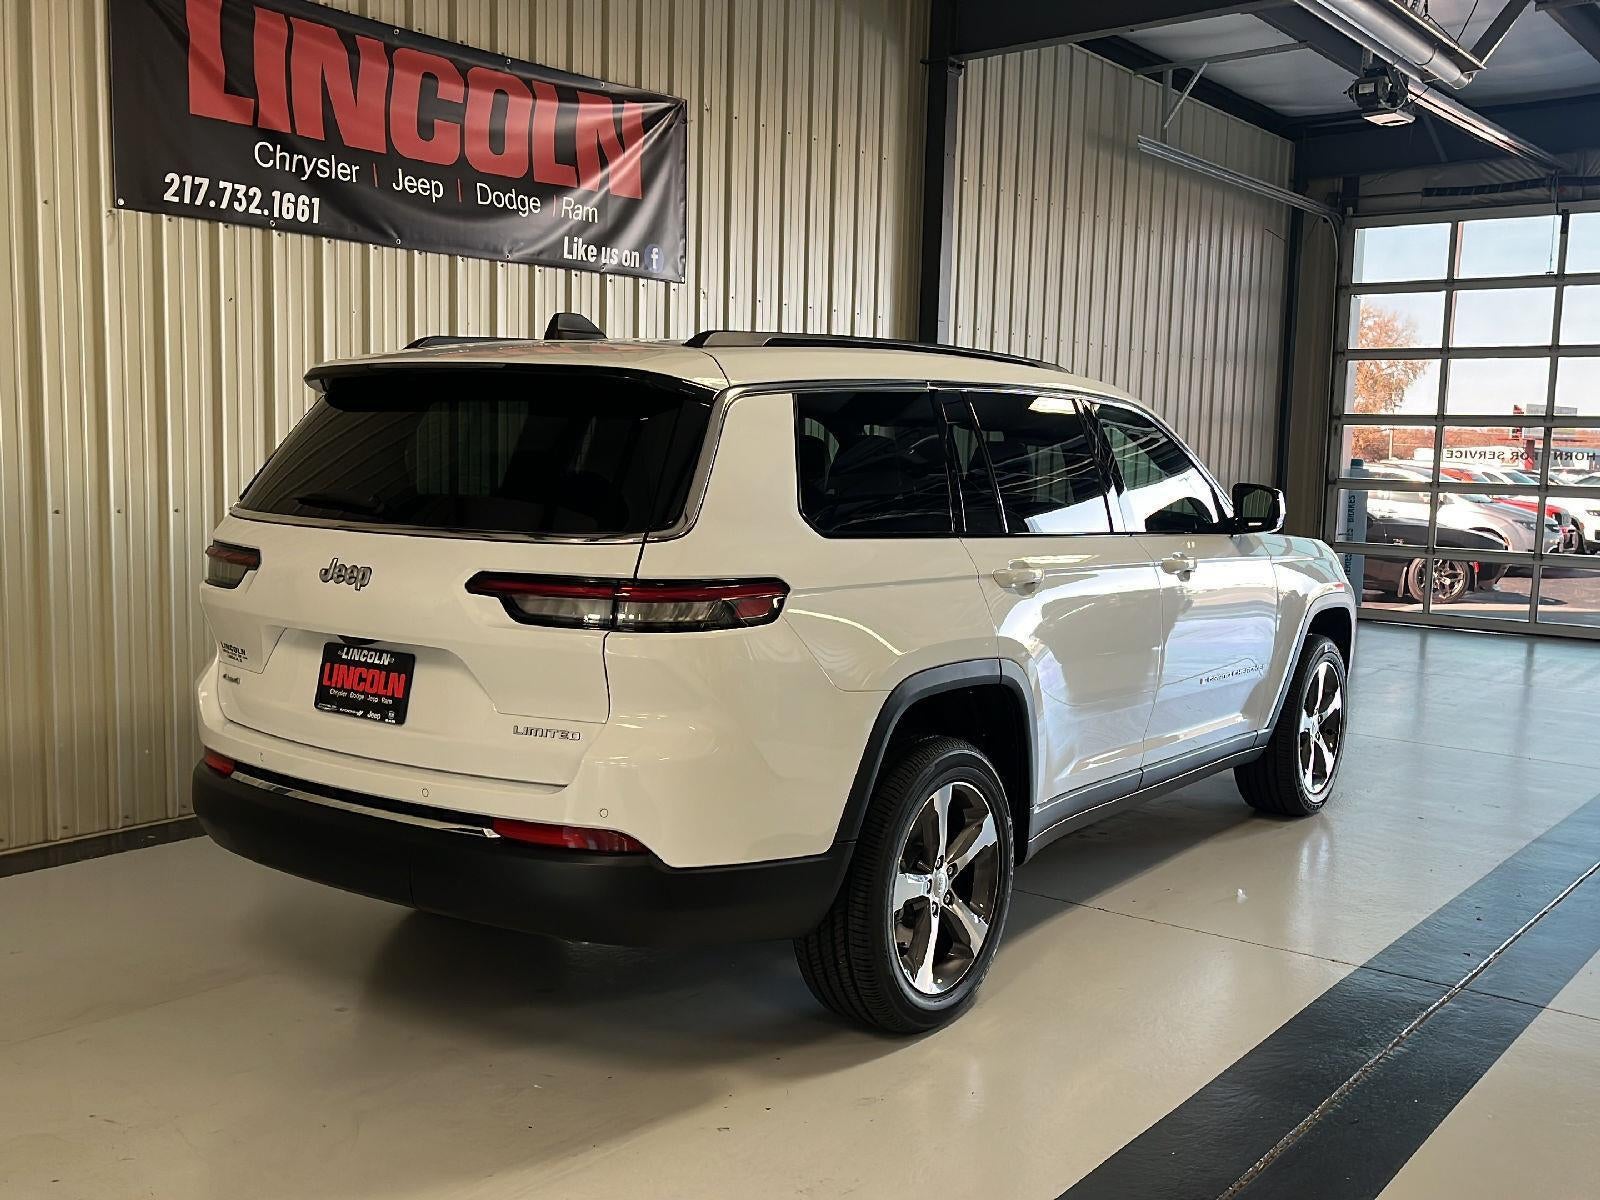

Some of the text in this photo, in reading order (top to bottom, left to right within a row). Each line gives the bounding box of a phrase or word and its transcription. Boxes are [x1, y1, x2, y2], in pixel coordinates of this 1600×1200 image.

[187, 0, 644, 199] LINCOLN
[163, 172, 320, 224] 217.732.1661
[254, 141, 599, 224] Chrysler Jeep Dodge Ram
[563, 236, 597, 262] Like
[601, 247, 618, 265] us
[622, 250, 640, 268] on
[319, 557, 373, 591] Jeep
[341, 647, 391, 666] LINCOLN
[322, 662, 406, 699] LINCOLN
[512, 725, 582, 741] LIMITED
